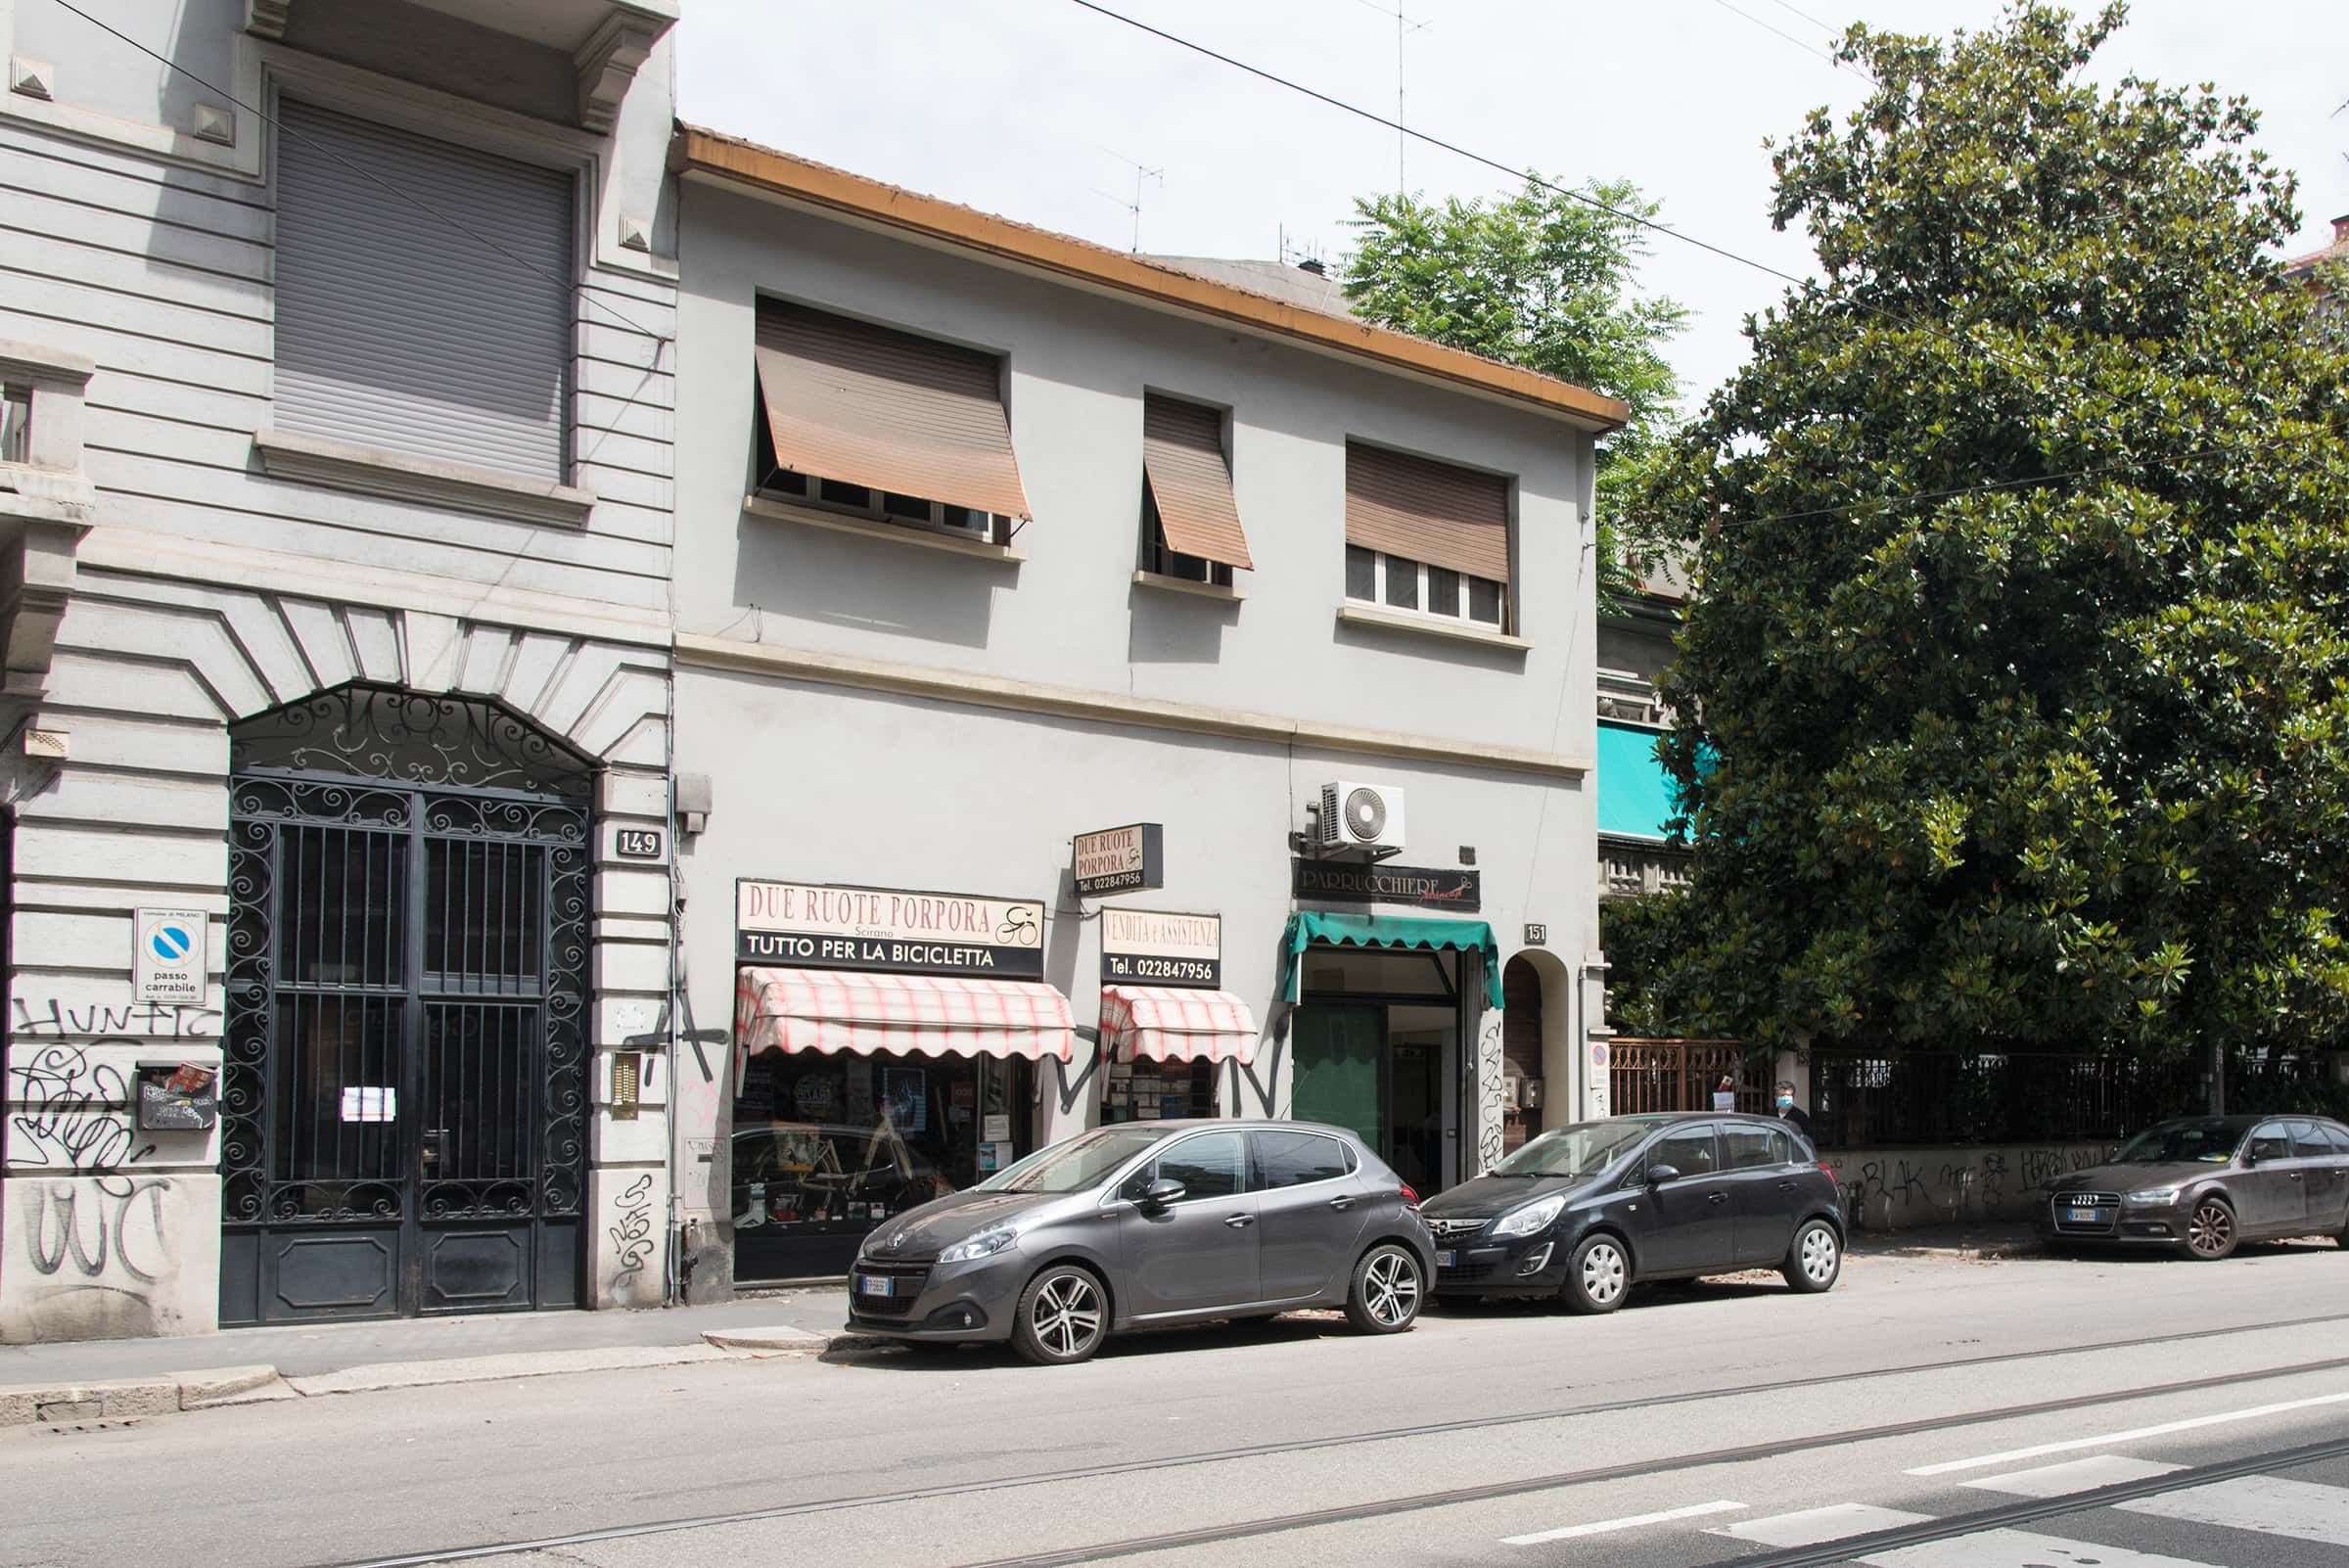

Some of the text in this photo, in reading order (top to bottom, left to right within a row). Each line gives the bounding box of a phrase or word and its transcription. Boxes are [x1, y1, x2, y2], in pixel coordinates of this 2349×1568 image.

[622, 832, 657, 853] 149
[1078, 830, 1133, 855] DUE RUOTE
[1079, 853, 1124, 878] PORPORA
[1080, 872, 1141, 893] Tel. 022847956
[1301, 870, 1439, 895] PARRUCCHIERE
[750, 885, 990, 933] DUE RUOTE PORPORA
[1104, 912, 1150, 944] VENDITA
[1159, 916, 1219, 947] ASSISTENZA
[1528, 925, 1545, 941] 151
[747, 935, 994, 967] TUTTO PER LA BICICLETTA
[154, 972, 188, 981] passo
[1110, 957, 1213, 980] Tel. 022847956
[145, 983, 196, 992] carrabile
